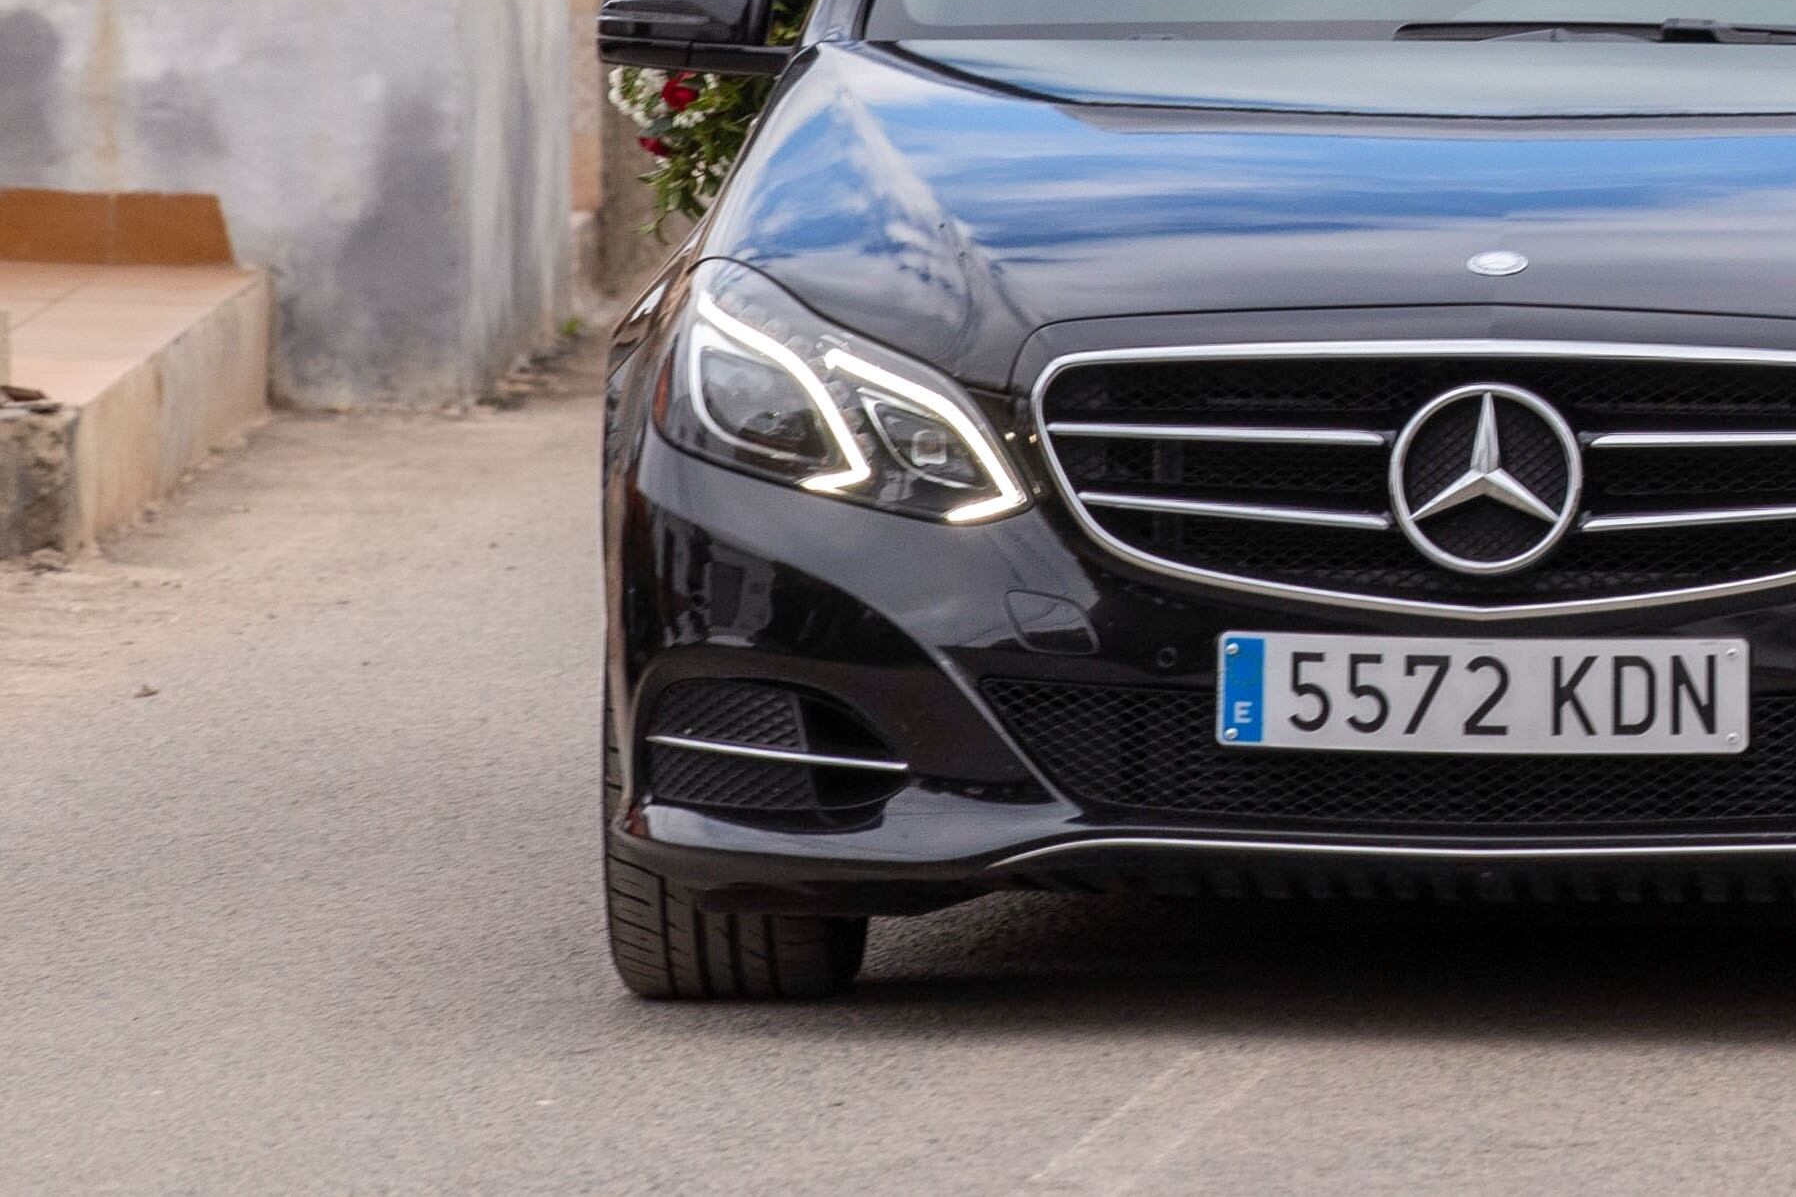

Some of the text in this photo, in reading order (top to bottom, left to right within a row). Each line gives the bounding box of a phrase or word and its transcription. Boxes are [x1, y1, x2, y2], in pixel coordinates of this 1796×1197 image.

[1233, 651, 1718, 736] E 5572 KDN
